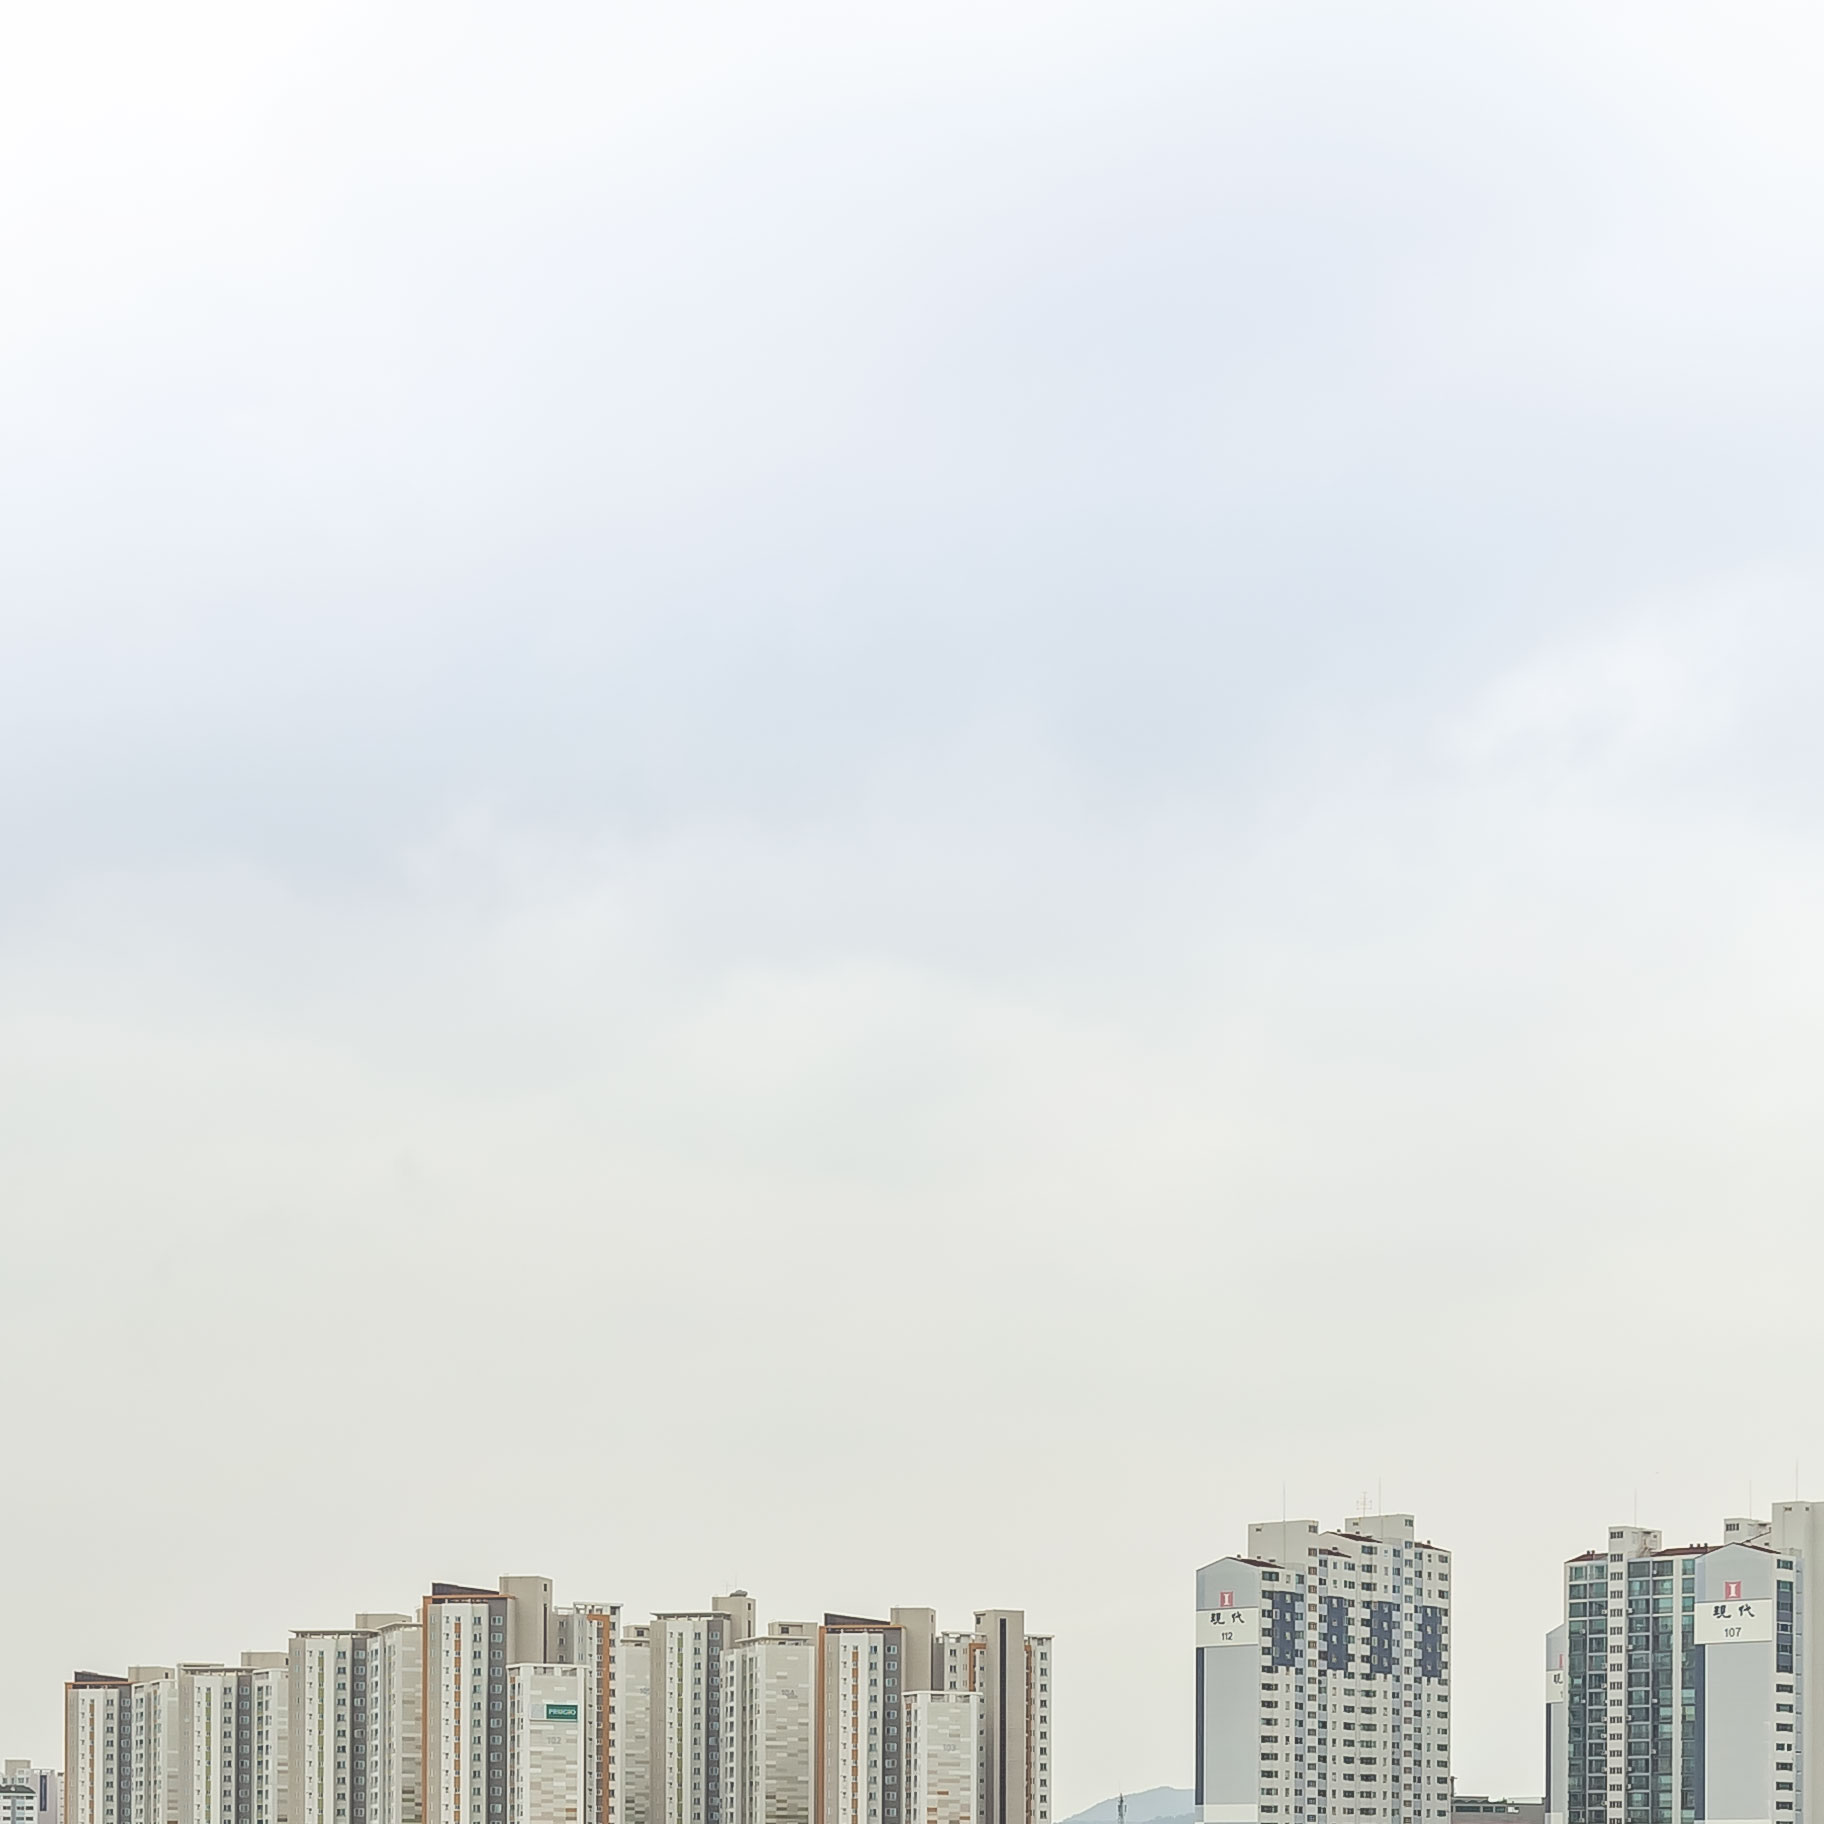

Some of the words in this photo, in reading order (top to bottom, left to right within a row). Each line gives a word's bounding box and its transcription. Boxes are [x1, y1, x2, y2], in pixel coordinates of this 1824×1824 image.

[1221, 1632, 1233, 1640] 112
[1724, 1627, 1741, 1638] 107
[547, 1737, 561, 1745] 102
